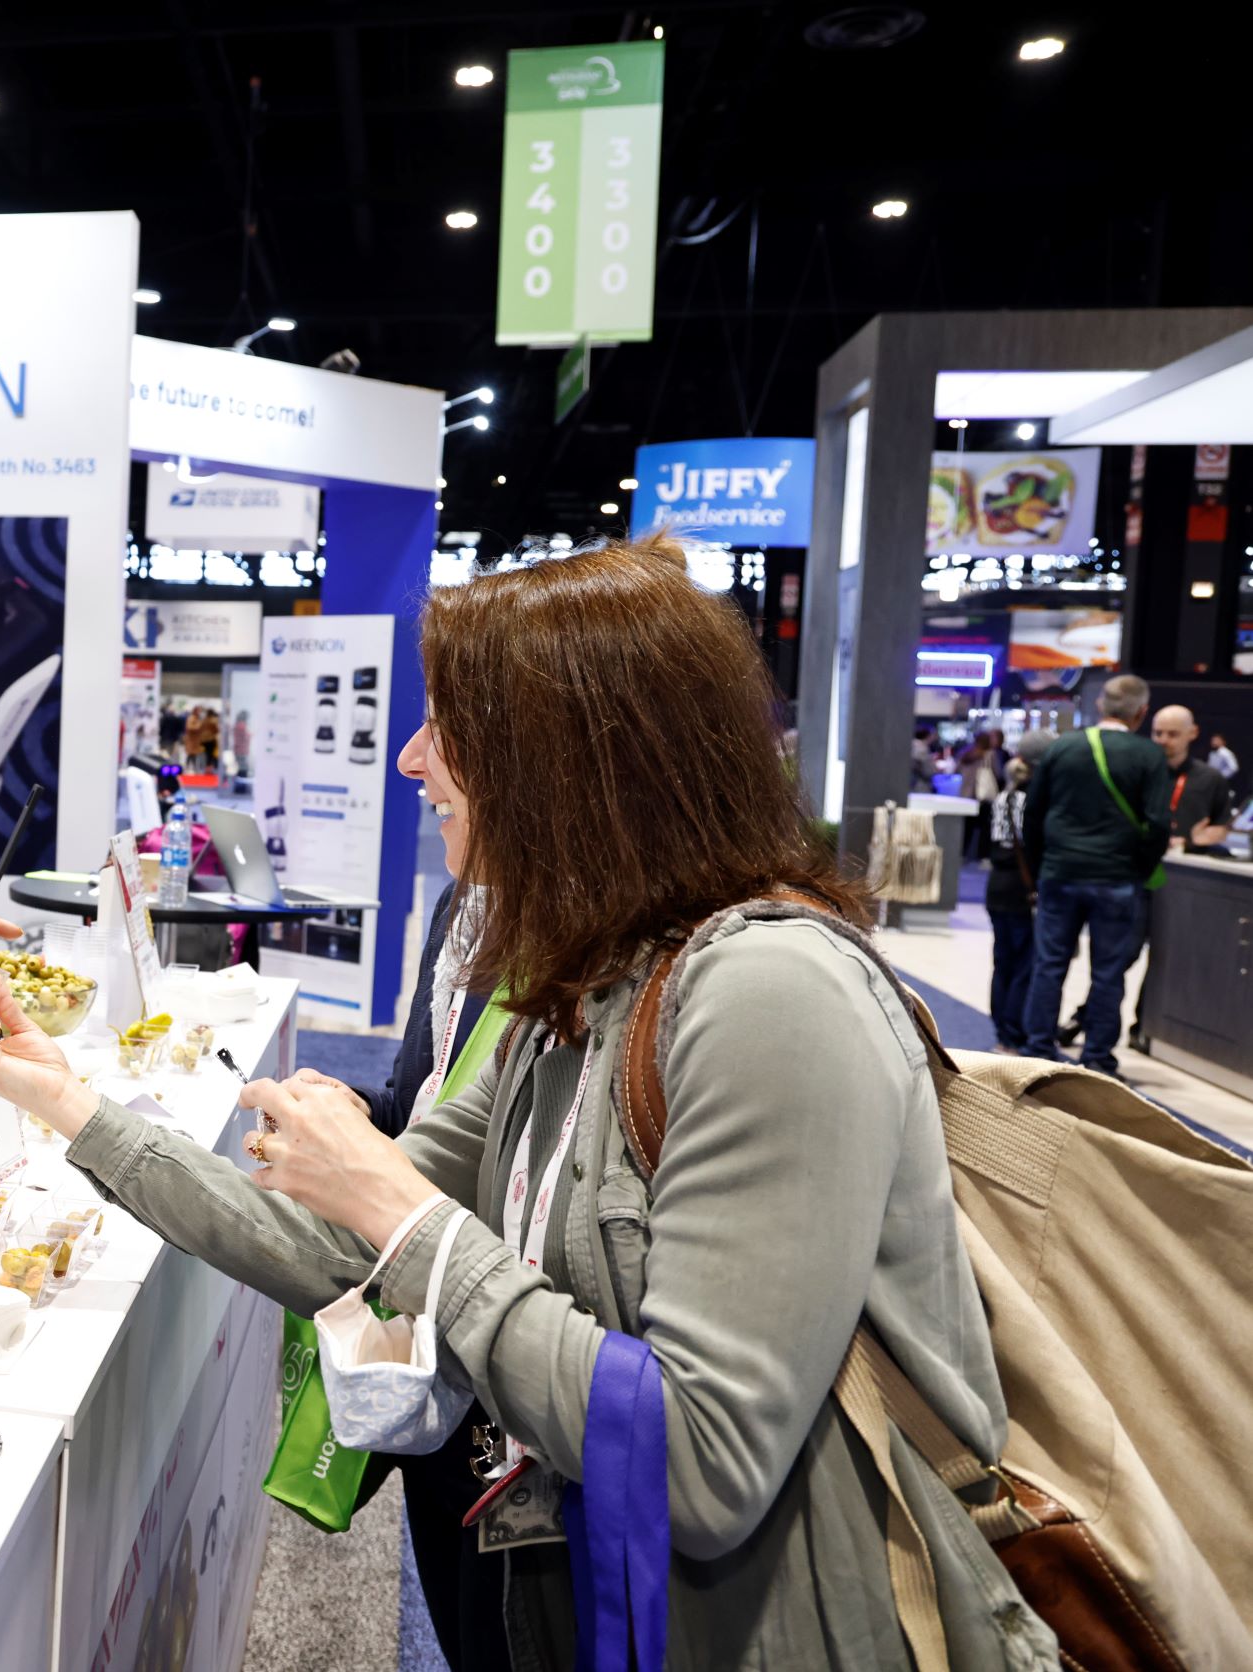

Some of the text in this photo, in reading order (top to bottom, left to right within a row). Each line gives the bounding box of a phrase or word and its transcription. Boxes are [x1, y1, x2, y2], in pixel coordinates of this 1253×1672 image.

[524, 140, 556, 298] 3400
[600, 137, 632, 294] 3300
[158, 381, 221, 413] future
[229, 397, 247, 416] to
[254, 404, 315, 428] come!
[652, 502, 786, 527] Foodservice
[290, 637, 345, 653] KEENON
[425, 1009, 457, 1096] Restaurant365
